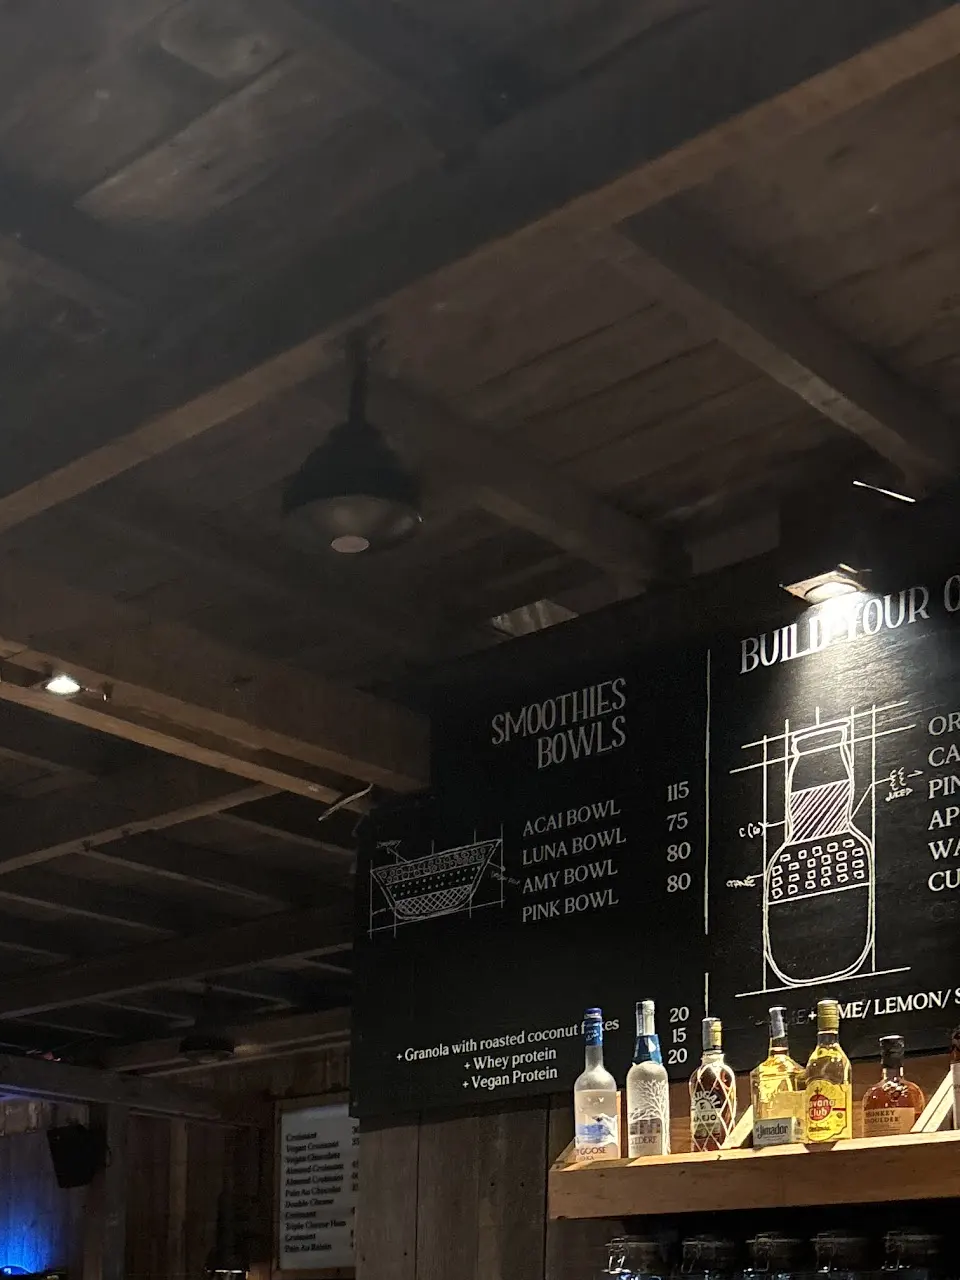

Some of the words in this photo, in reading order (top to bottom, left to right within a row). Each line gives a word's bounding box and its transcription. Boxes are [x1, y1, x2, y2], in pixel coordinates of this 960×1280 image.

[740, 614, 830, 674] BUILD
[491, 677, 627, 745] SMOOTHIES
[537, 715, 627, 769] BOWLS
[666, 781, 690, 802] 115
[522, 811, 563, 837] ACAI
[566, 799, 622, 827] BOWL
[666, 811, 689, 832] 75
[522, 841, 569, 866] LUNA
[572, 827, 627, 854] BOWL
[666, 841, 691, 862] 80
[522, 869, 561, 894] AMY
[563, 859, 618, 886] BOWL
[666, 872, 691, 893] 80
[522, 897, 561, 923] PINK
[564, 888, 620, 916] BOWL
[669, 1006, 690, 1024] 20
[405, 1043, 450, 1062] Granola
[452, 1036, 477, 1055] with
[480, 1030, 526, 1051] roasted
[527, 1024, 579, 1046] coconut
[672, 1028, 687, 1044] 15
[473, 1054, 509, 1072] Whey
[512, 1047, 557, 1068] protein
[668, 1047, 688, 1065] 20
[471, 1072, 510, 1092] Vegan
[512, 1066, 558, 1085] Protein
